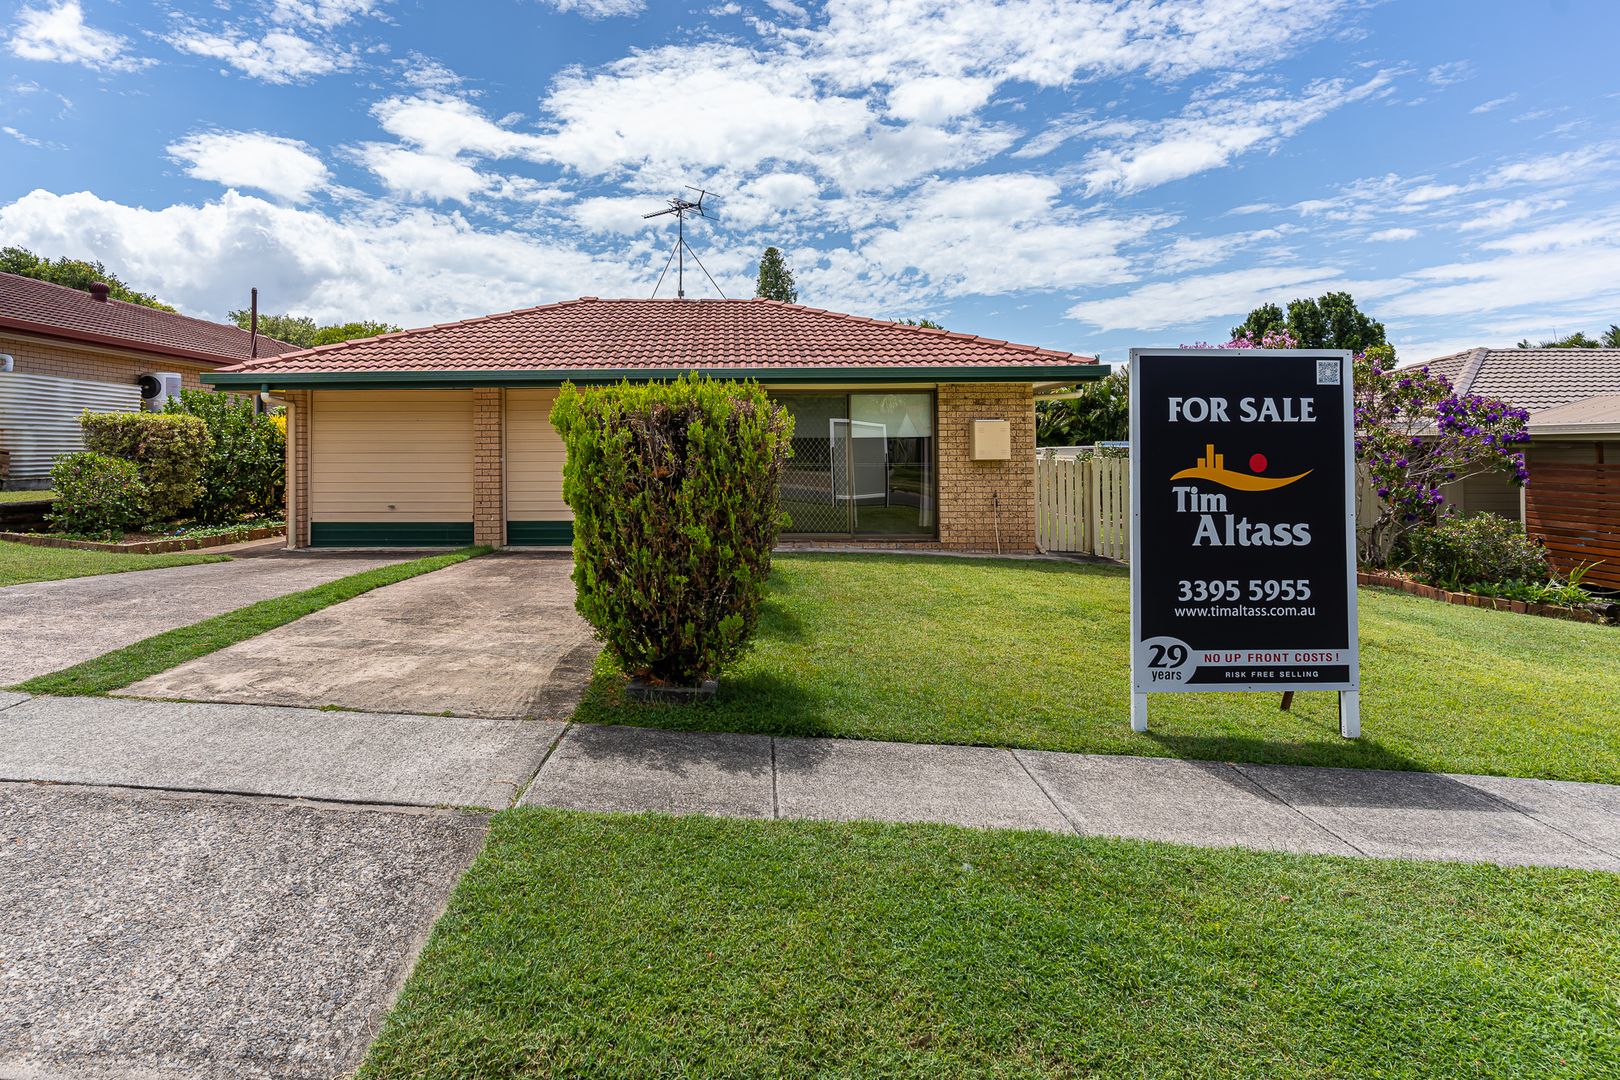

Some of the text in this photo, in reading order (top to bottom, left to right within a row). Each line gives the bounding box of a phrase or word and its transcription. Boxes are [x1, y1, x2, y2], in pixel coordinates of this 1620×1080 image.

[1168, 397, 1317, 422] FOR SALE
[1171, 486, 1227, 512] Tim
[1192, 514, 1312, 546] Altass
[1178, 579, 1311, 601] 3395 5955
[1174, 604, 1316, 617] www.timaltass.com.au
[1148, 644, 1188, 669] 29
[1204, 653, 1220, 663] NO
[1225, 653, 1241, 663] UP
[1247, 653, 1289, 662] FRONT
[1151, 669, 1182, 682] years
[1279, 670, 1319, 678] SELLING
